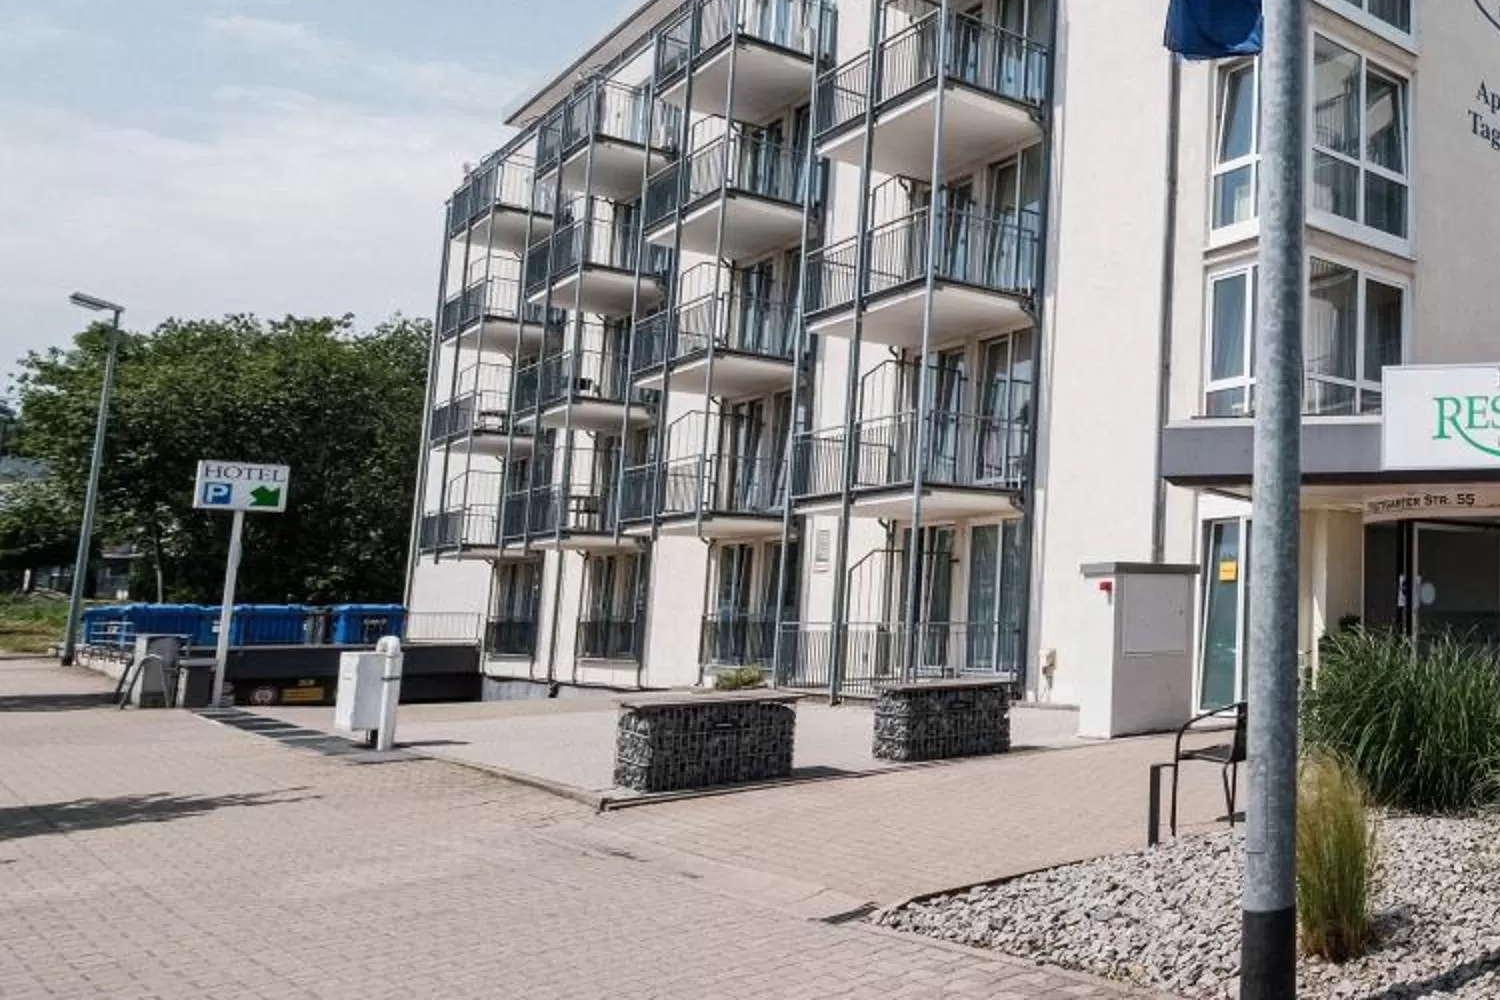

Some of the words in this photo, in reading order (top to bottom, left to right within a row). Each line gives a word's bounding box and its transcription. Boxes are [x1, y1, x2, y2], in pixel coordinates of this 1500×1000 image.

[204, 465, 286, 483] HOTEL
[207, 483, 229, 503] P
[1456, 493, 1476, 506] 55
